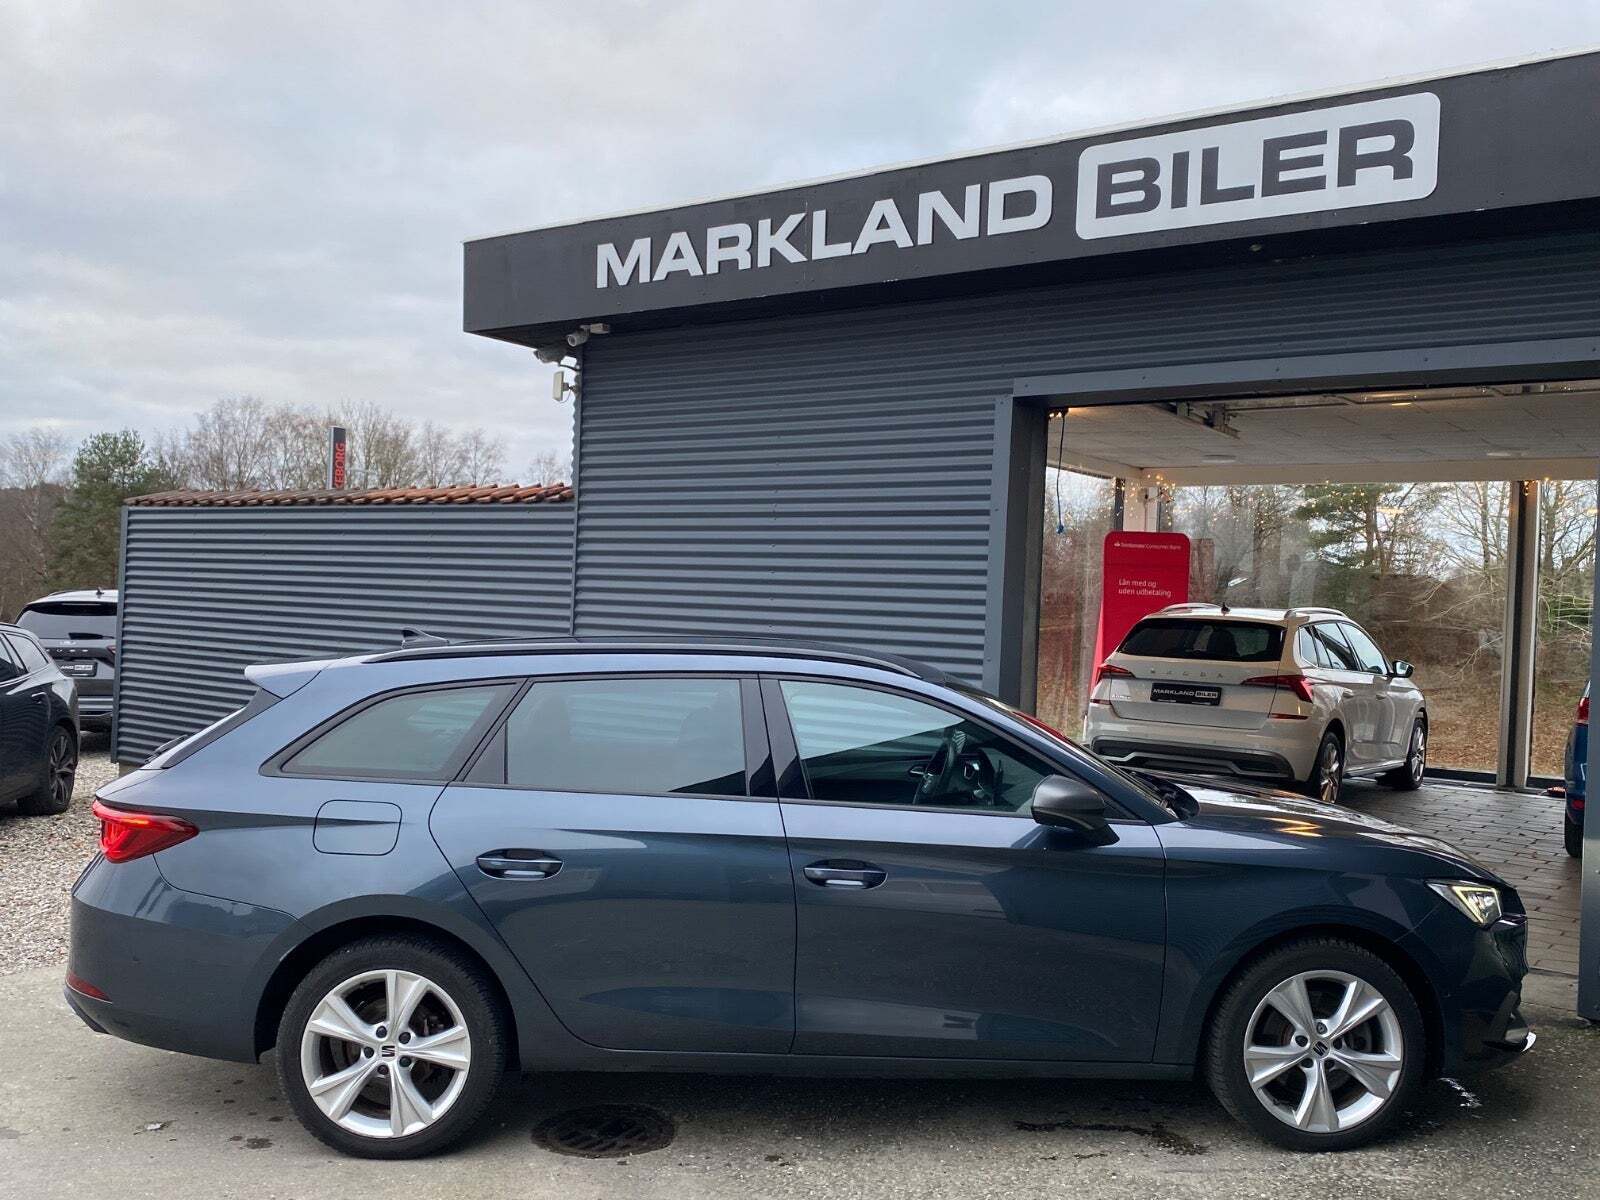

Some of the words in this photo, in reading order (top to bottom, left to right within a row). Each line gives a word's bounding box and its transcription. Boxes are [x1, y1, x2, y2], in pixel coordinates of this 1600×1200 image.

[596, 173, 1053, 290] MARKLAND
[1095, 118, 1415, 219] BILER
[1118, 578, 1131, 587] Lån
[1147, 581, 1157, 589] og
[1136, 589, 1172, 599] udbetaling
[1152, 687, 1195, 697] MARKLAND
